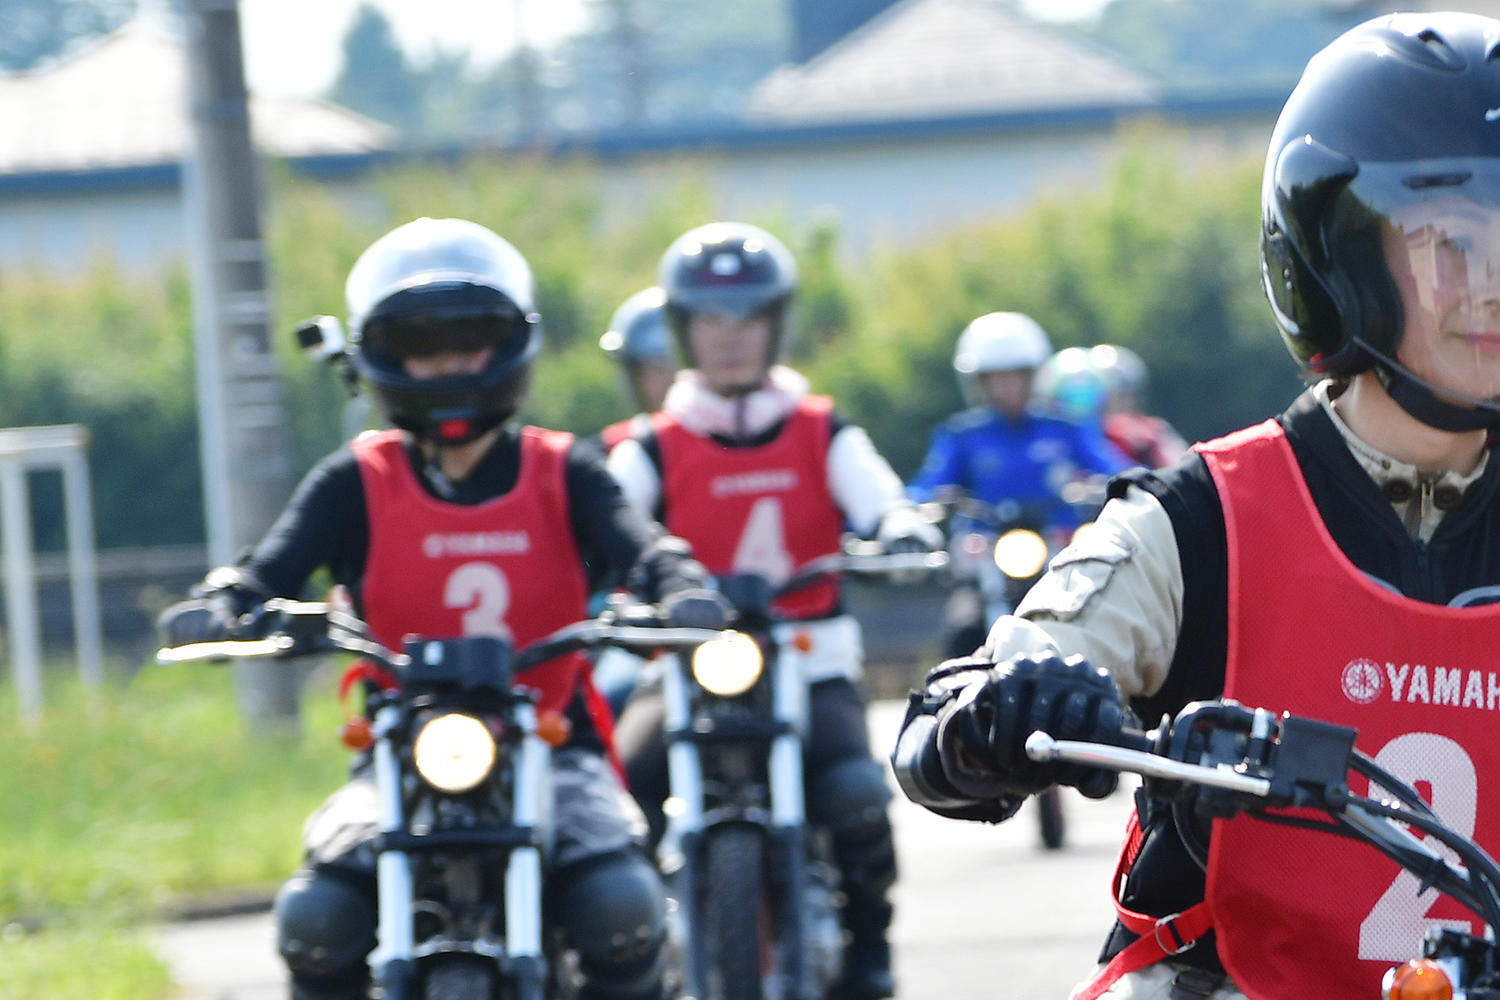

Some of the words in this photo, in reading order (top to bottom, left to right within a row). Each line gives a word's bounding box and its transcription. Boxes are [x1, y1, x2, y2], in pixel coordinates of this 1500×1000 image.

[732, 497, 796, 587] 4
[444, 562, 515, 641] 3
[1358, 732, 1477, 962] 2
